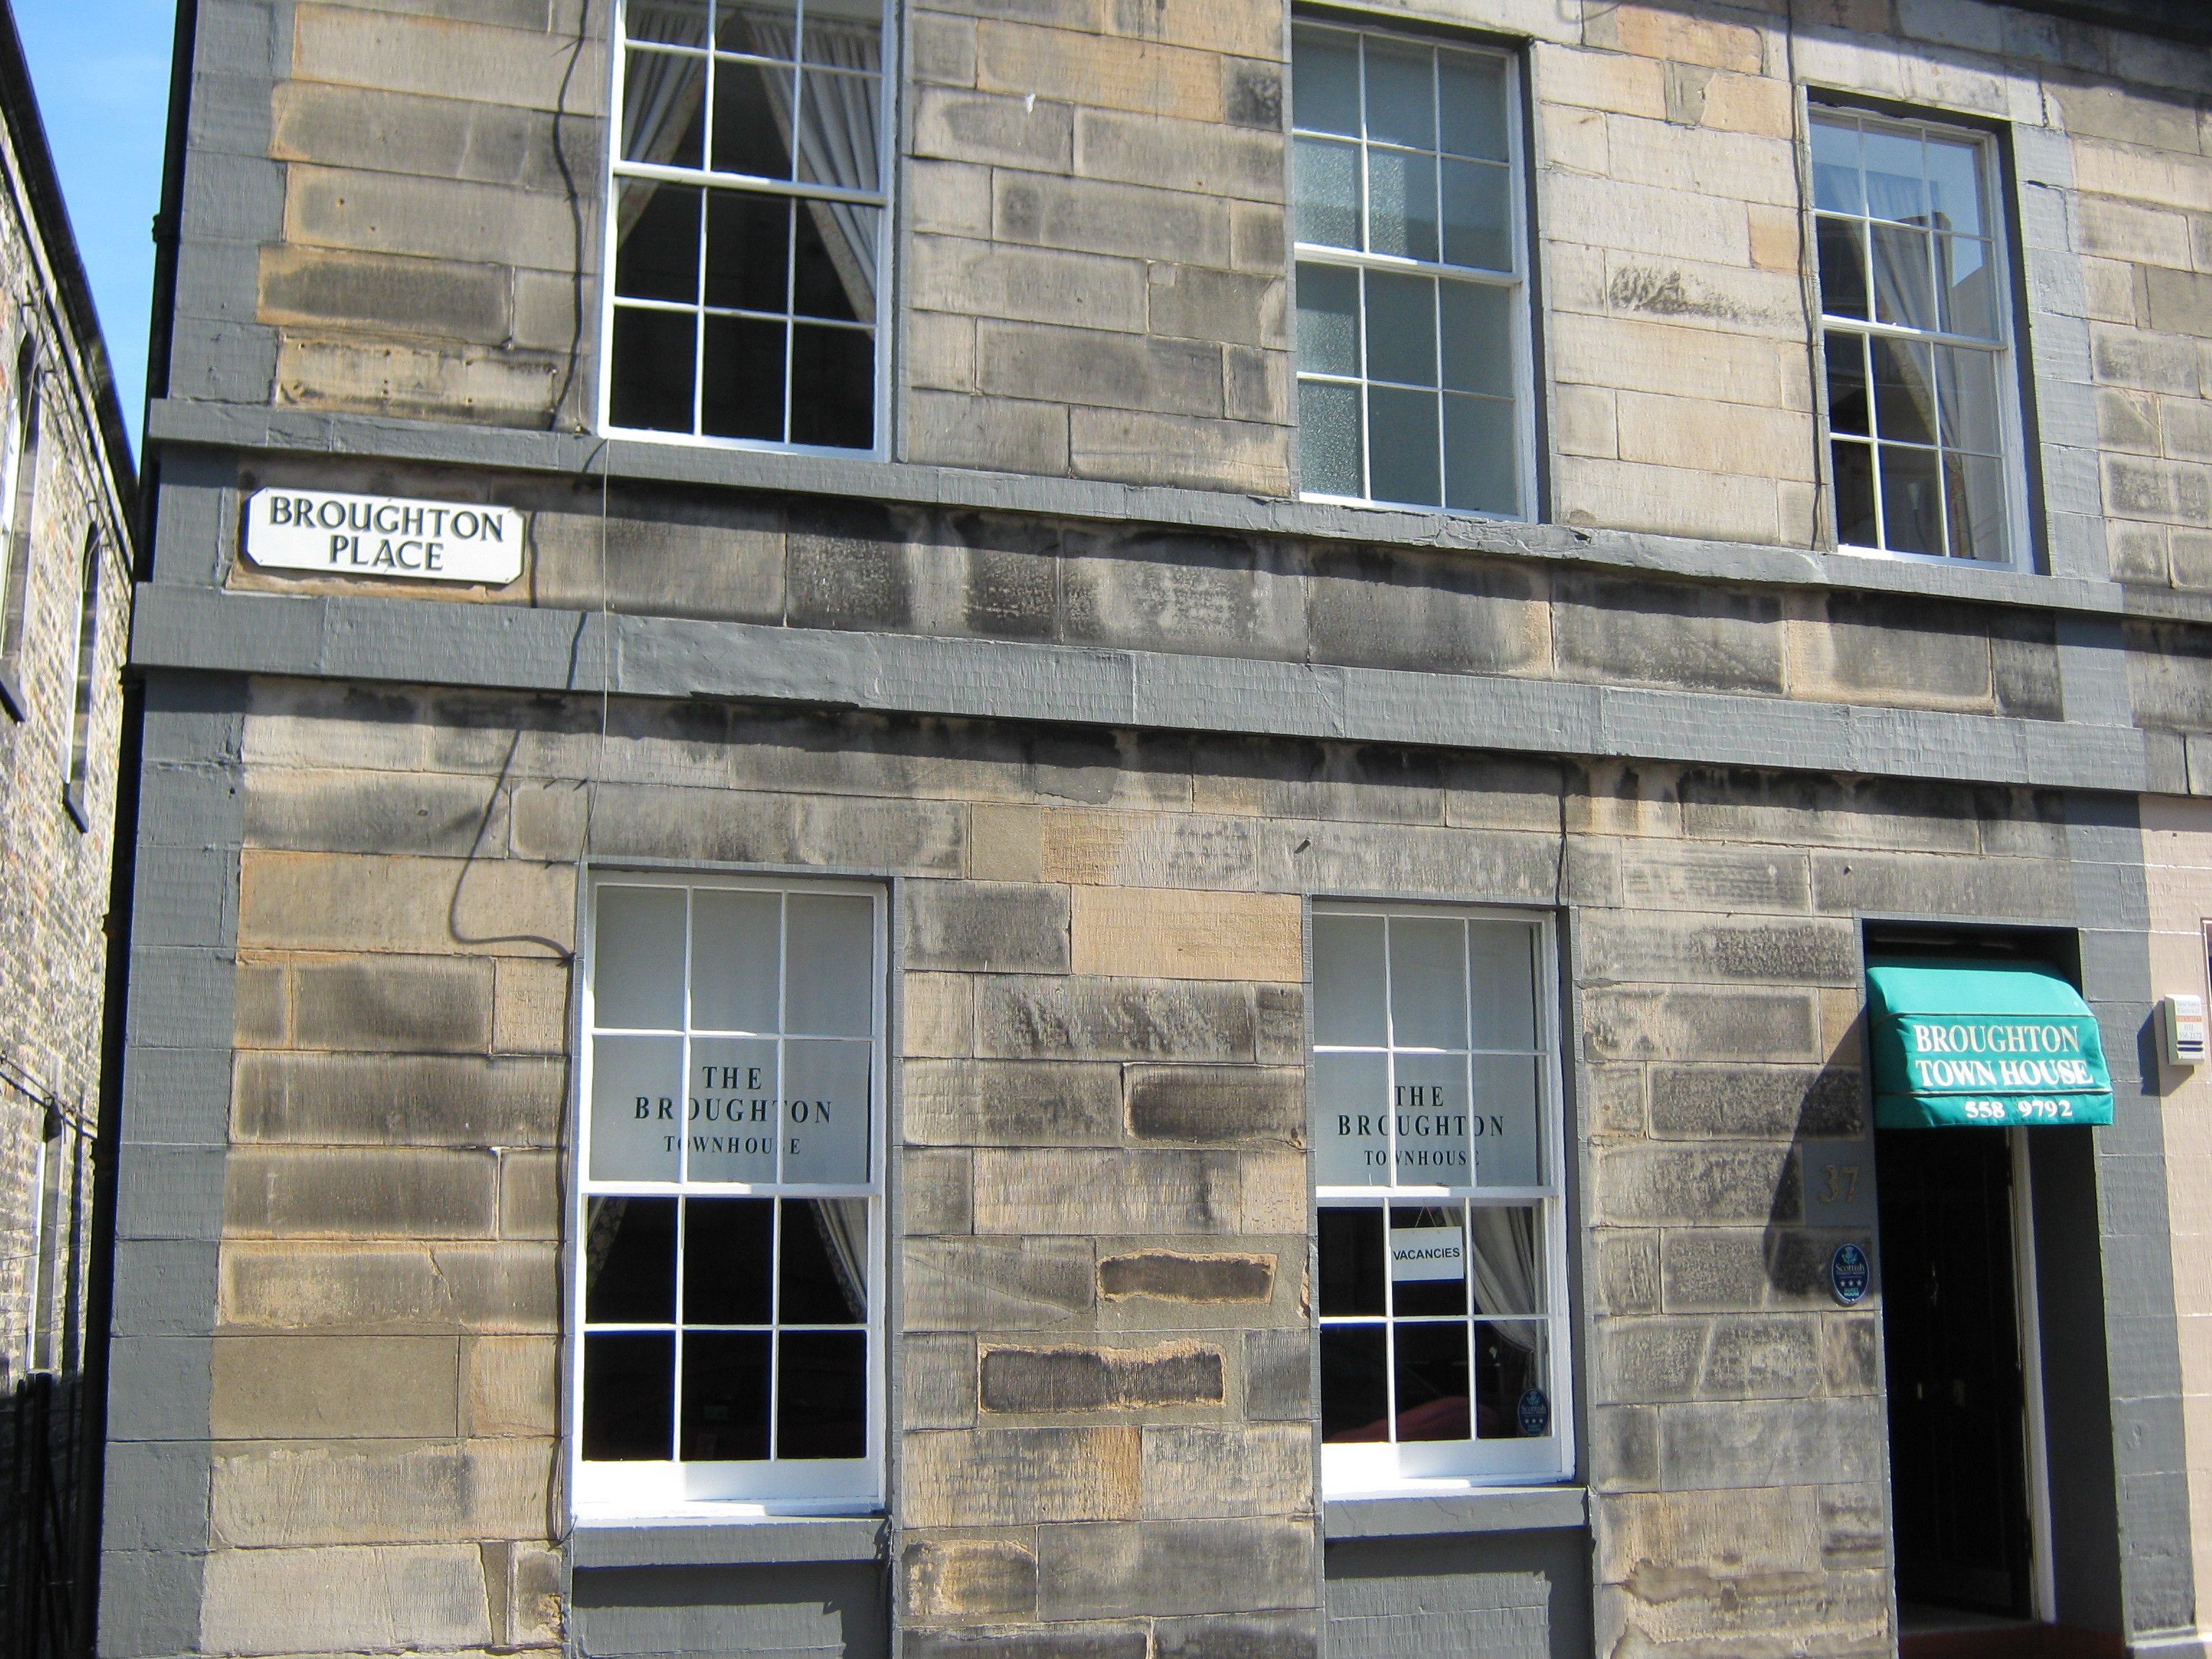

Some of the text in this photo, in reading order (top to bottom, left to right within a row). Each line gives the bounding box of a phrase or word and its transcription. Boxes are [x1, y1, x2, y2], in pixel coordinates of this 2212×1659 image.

[269, 496, 503, 543] BROUGHTON
[329, 535, 444, 571] PLACE
[1912, 1024, 2080, 1053] BROUGHTON
[702, 1066, 762, 1090] THE
[1915, 1059, 2093, 1087] TOWN HOUSE
[1395, 1086, 1444, 1107] THE
[1965, 1100, 2073, 1118] 558 9792
[1337, 1114, 1503, 1137] BROUGHTON
[663, 1135, 801, 1155] TWNHOUE
[1819, 1164, 1860, 1203] 37
[1393, 1246, 1460, 1261] VACANCIES
